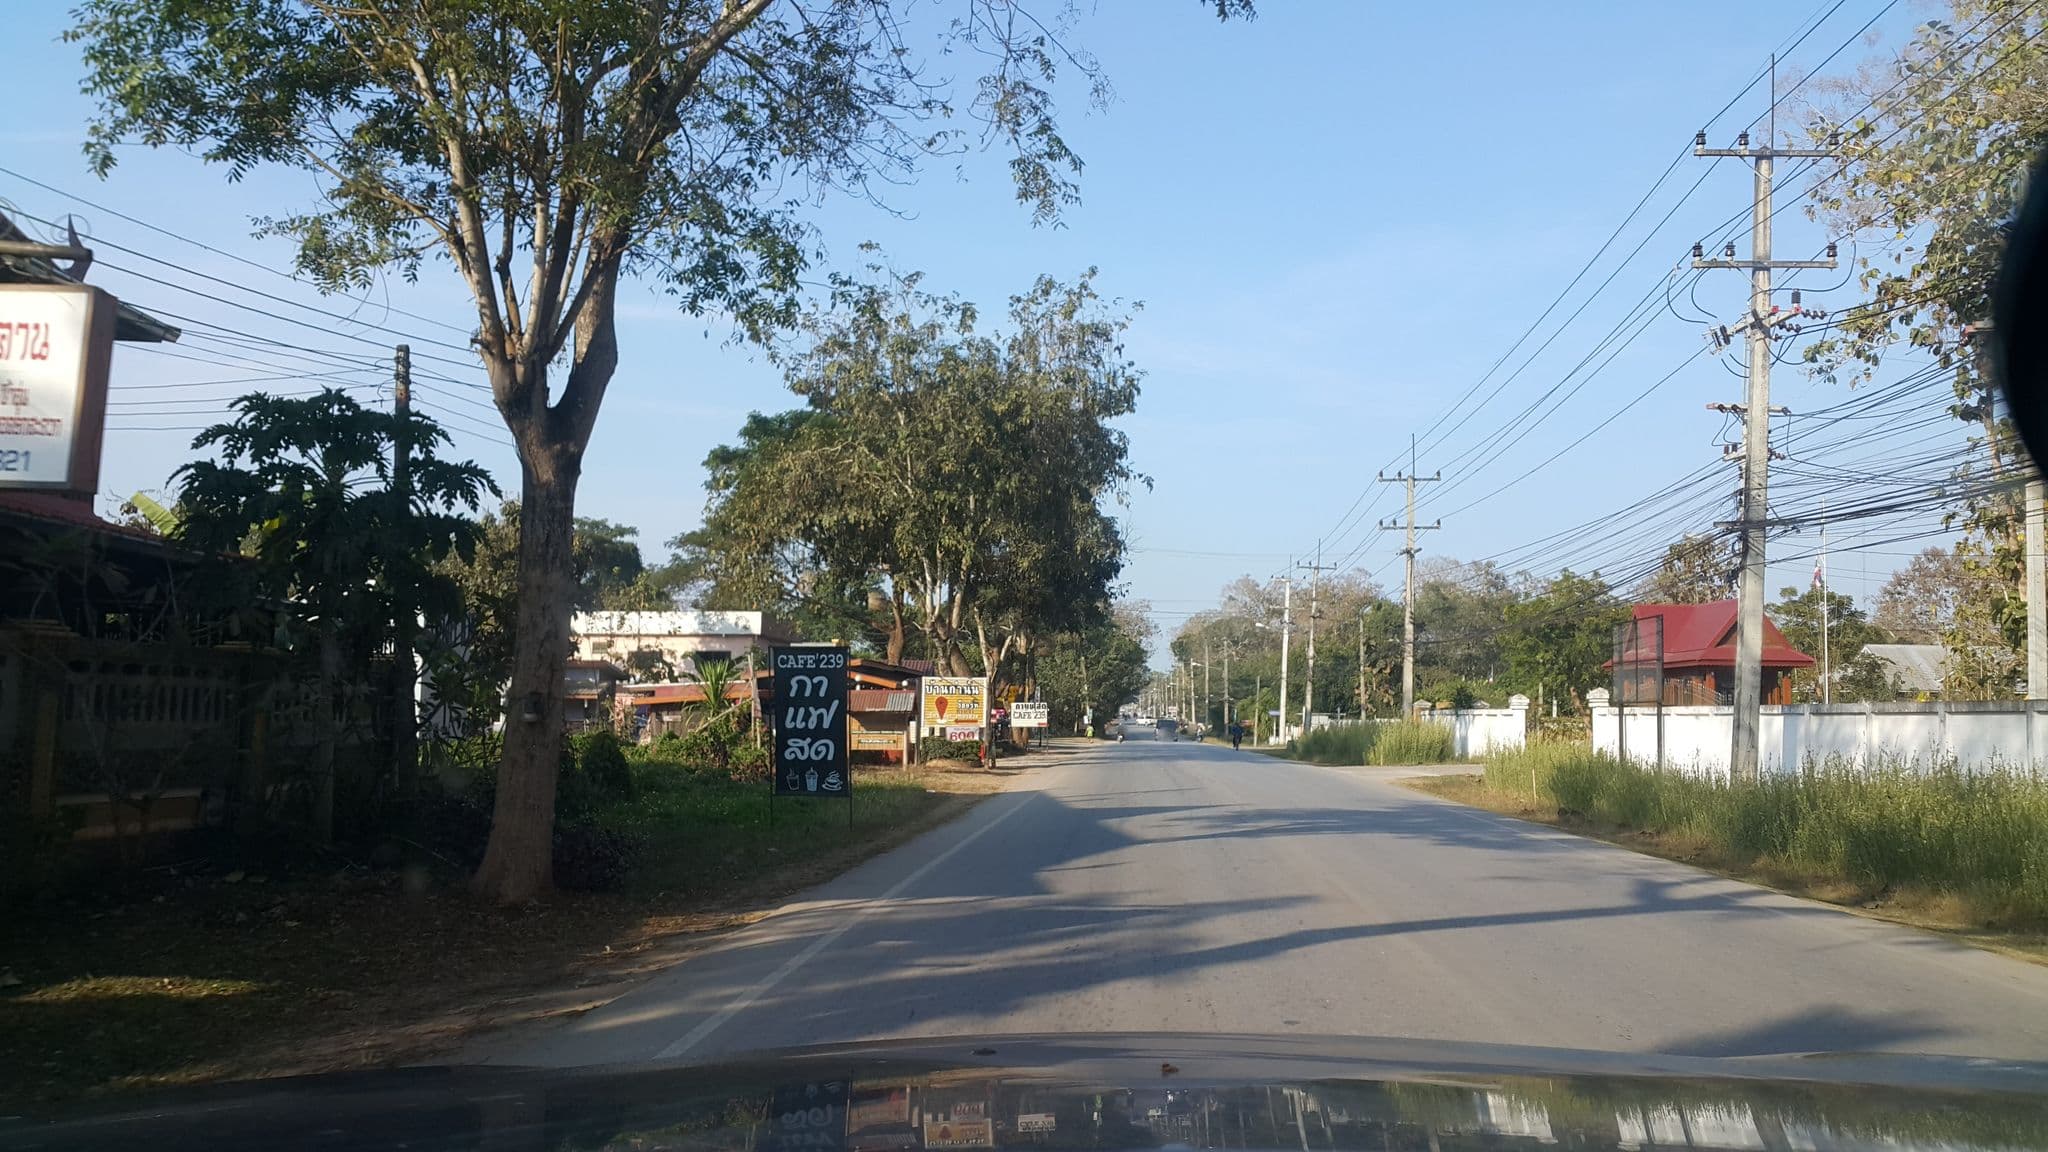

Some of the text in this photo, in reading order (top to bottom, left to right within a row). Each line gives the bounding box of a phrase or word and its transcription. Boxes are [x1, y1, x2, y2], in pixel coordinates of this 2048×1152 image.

[789, 675, 829, 698] กา
[925, 680, 979, 695] บ้านกำนัน
[784, 699, 840, 729] แฟ
[784, 737, 835, 761] สด
